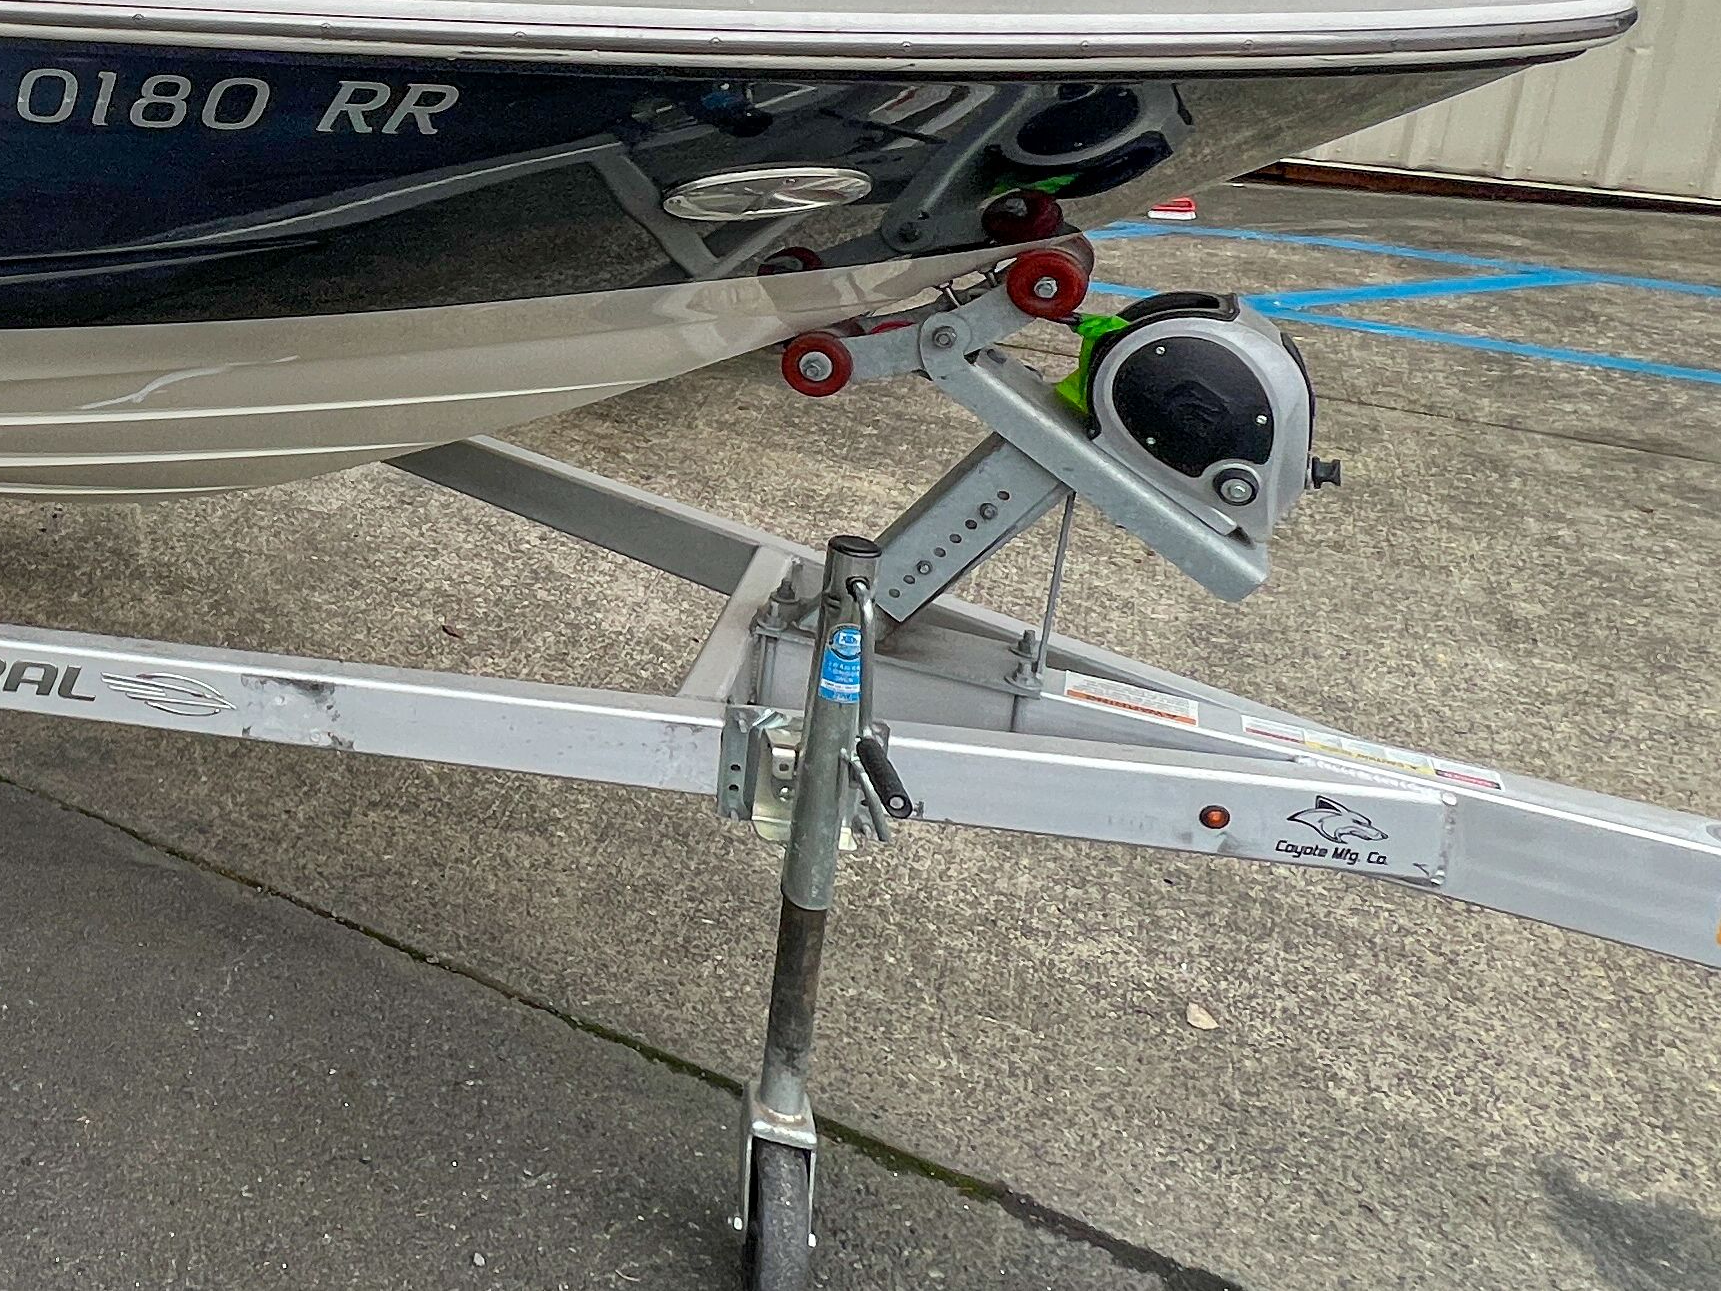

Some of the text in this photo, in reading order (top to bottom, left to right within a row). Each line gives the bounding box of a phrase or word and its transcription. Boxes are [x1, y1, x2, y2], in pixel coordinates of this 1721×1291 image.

[17, 69, 269, 129] 0180
[316, 81, 459, 134] RR
[1275, 840, 1328, 858] Coyote
